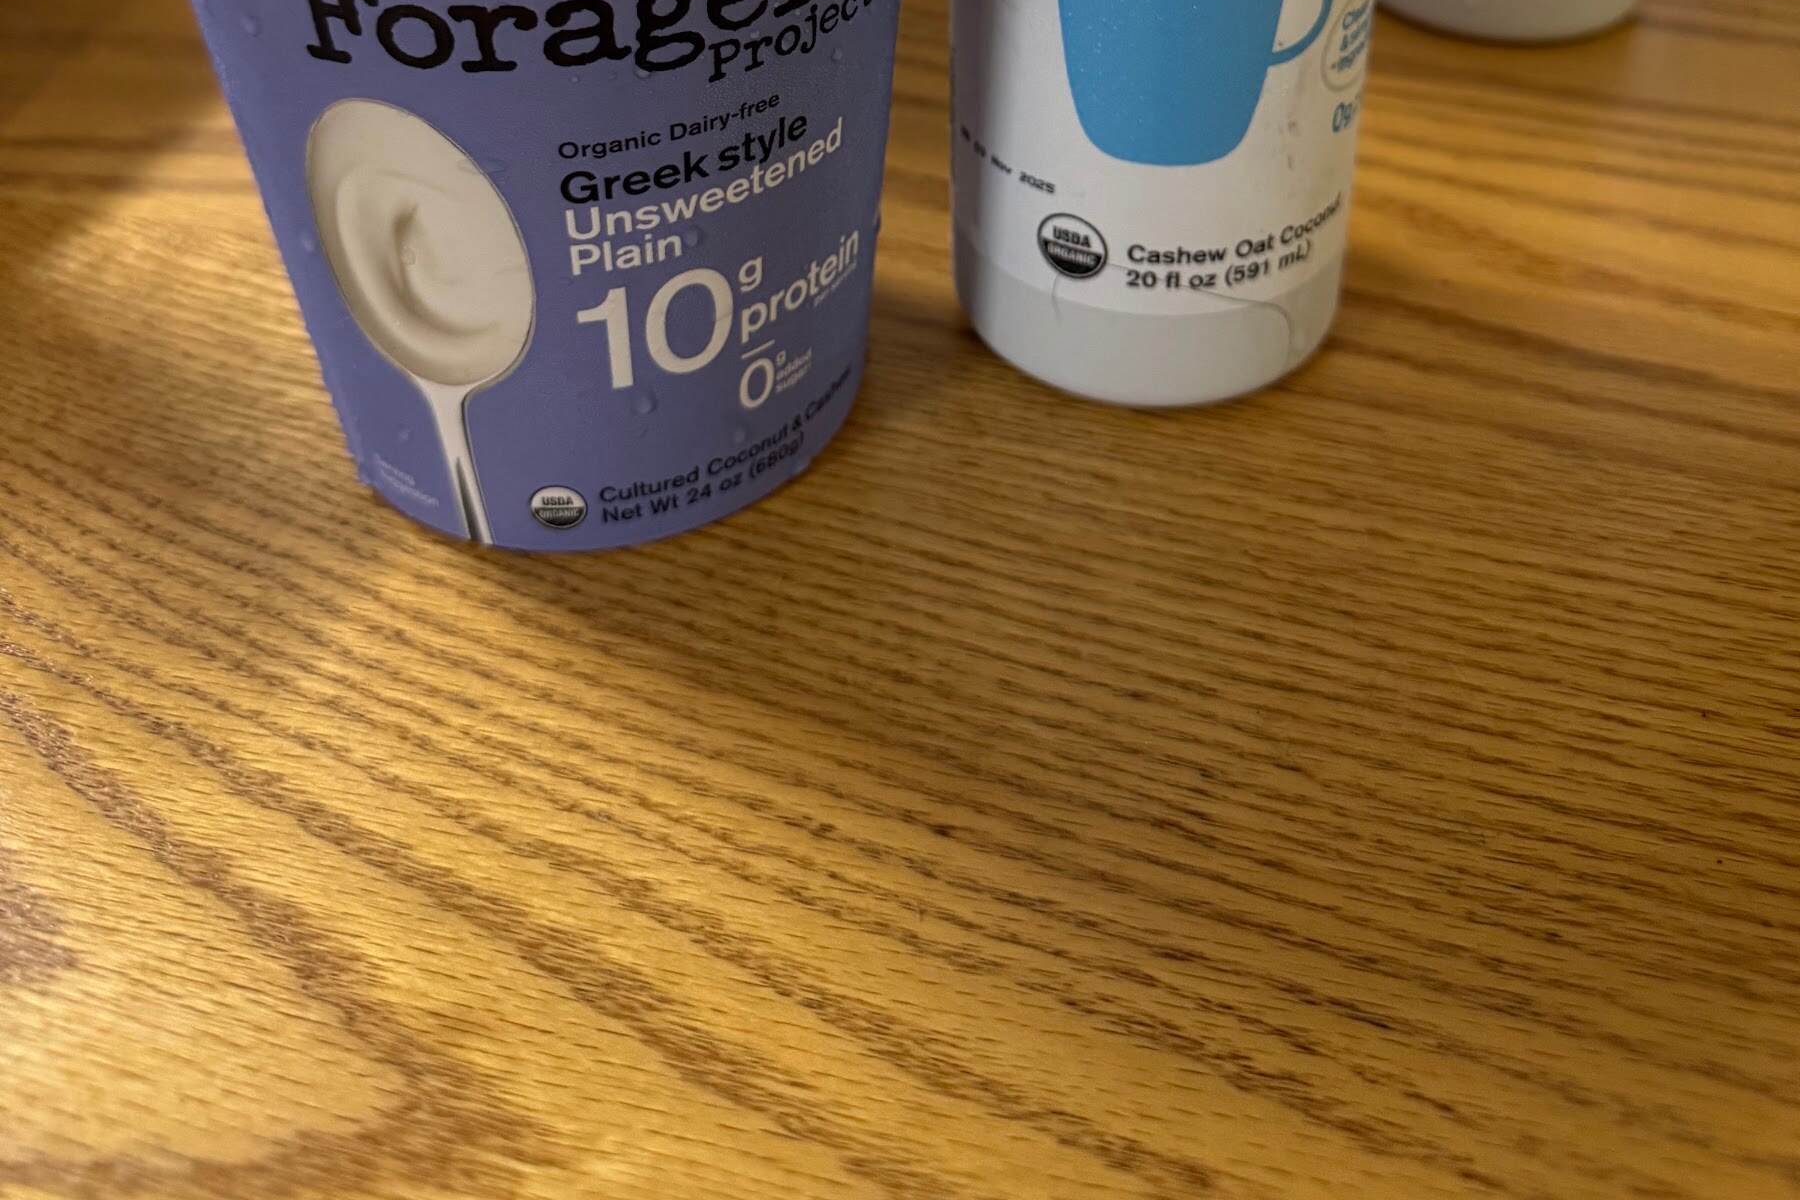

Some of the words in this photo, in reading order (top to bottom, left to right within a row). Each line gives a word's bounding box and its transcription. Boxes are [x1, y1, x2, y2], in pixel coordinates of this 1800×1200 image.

[558, 131, 661, 160] Organic
[669, 94, 780, 141] Dairy-free
[560, 151, 709, 204] Greek
[718, 115, 807, 171] style
[565, 116, 843, 240] Unsweetened
[1020, 171, 1056, 194] 2025
[569, 232, 682, 276] Plain
[1047, 243, 1098, 266] ORGANIC
[1052, 226, 1091, 248] USDA
[1127, 245, 1226, 265] Cashew
[1235, 233, 1275, 257] Oat
[741, 229, 859, 344] protein
[1126, 269, 1157, 288] 20
[1166, 271, 1180, 288] fl
[1189, 273, 1217, 289] oz
[1225, 260, 1269, 287] (591
[1278, 239, 1312, 271] mL)
[576, 268, 734, 390] 10
[739, 256, 763, 293] g
[600, 467, 699, 502] Cultured
[707, 424, 788, 476] Coconut
[792, 413, 802, 431] &
[603, 502, 642, 523] Net
[650, 492, 679, 515] Wt
[688, 483, 713, 504] 24
[719, 473, 744, 492] oz
[750, 431, 805, 481] (680g)
[539, 507, 580, 519] ORGANIC
[541, 495, 573, 506] USDA
